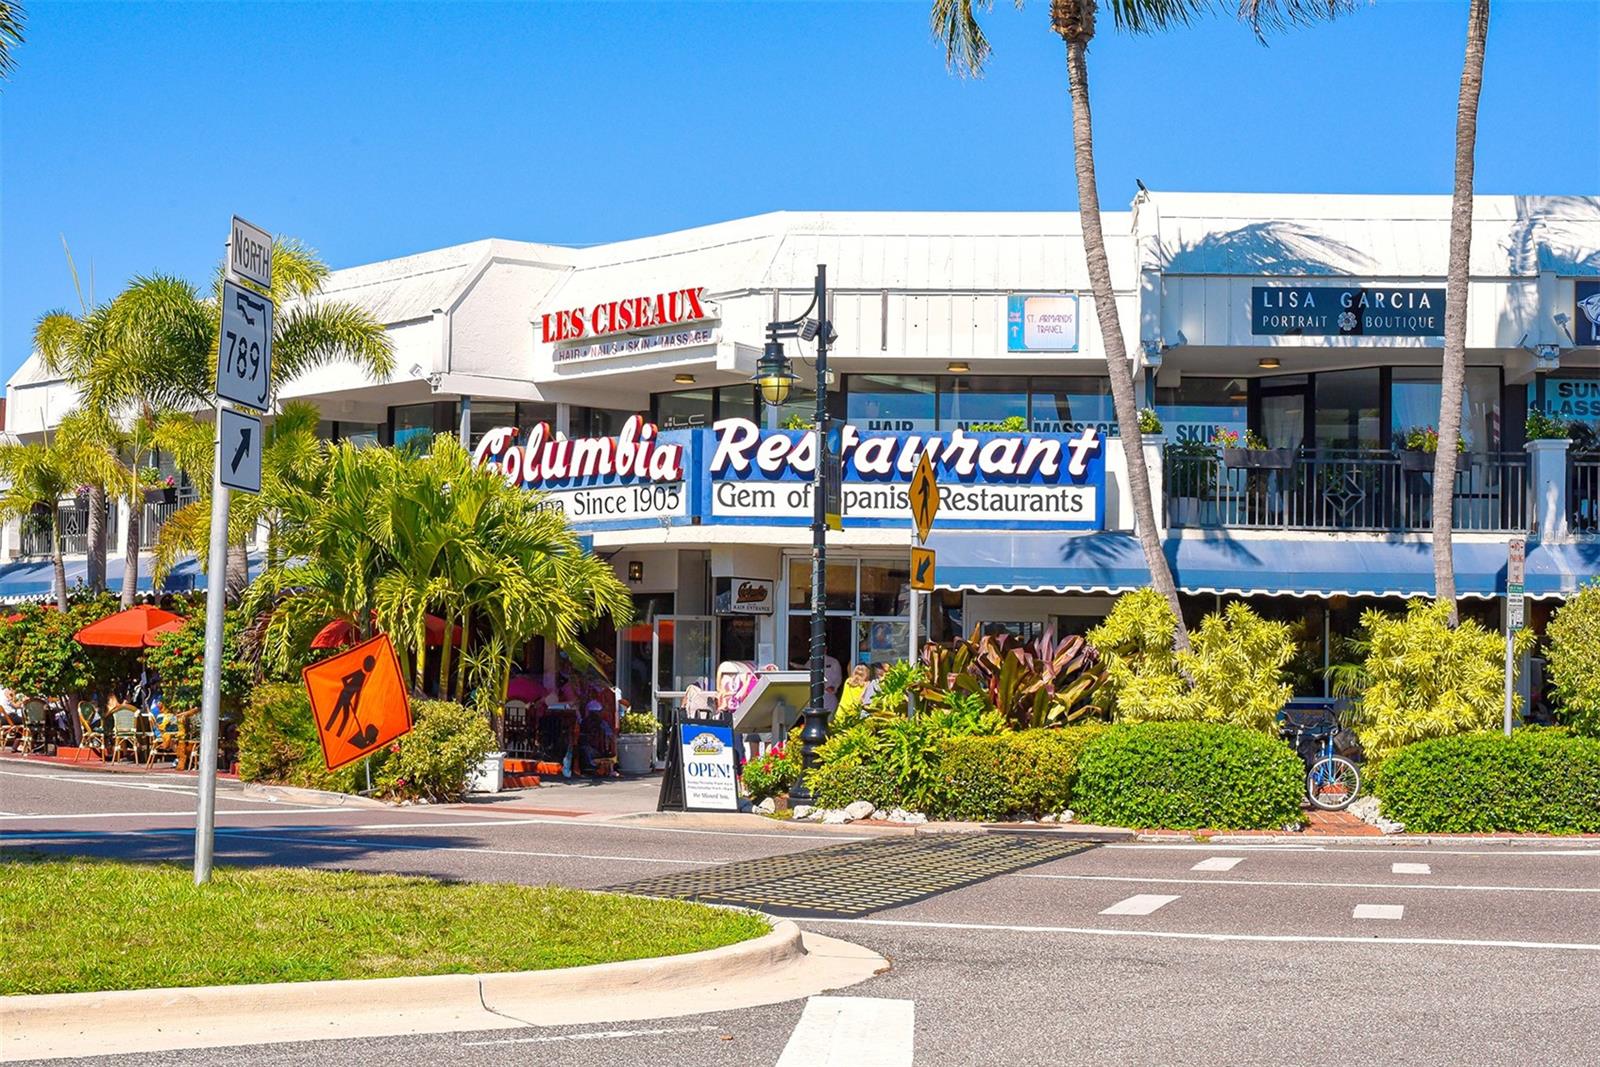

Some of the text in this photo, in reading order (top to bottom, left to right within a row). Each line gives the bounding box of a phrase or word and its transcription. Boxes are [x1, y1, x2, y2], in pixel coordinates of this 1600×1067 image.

[234, 227, 270, 279] NORTH
[541, 287, 704, 344] LES CISEAUX
[1263, 291, 1431, 309] LISA GARCIA
[1262, 315, 1435, 331] PORTRAIT BOUTIQUE
[226, 330, 260, 382] 789
[558, 330, 710, 362] HAIR NAILS SKIN MASSAGE
[709, 417, 1100, 480] Restaurant
[1175, 424, 1219, 444] SKIN
[472, 414, 684, 487] Columbia
[574, 491, 627, 516] Since
[633, 486, 680, 513] 1905
[716, 482, 1083, 515] Gem of panis Restaurants
[687, 762, 730, 778] OPEN!
